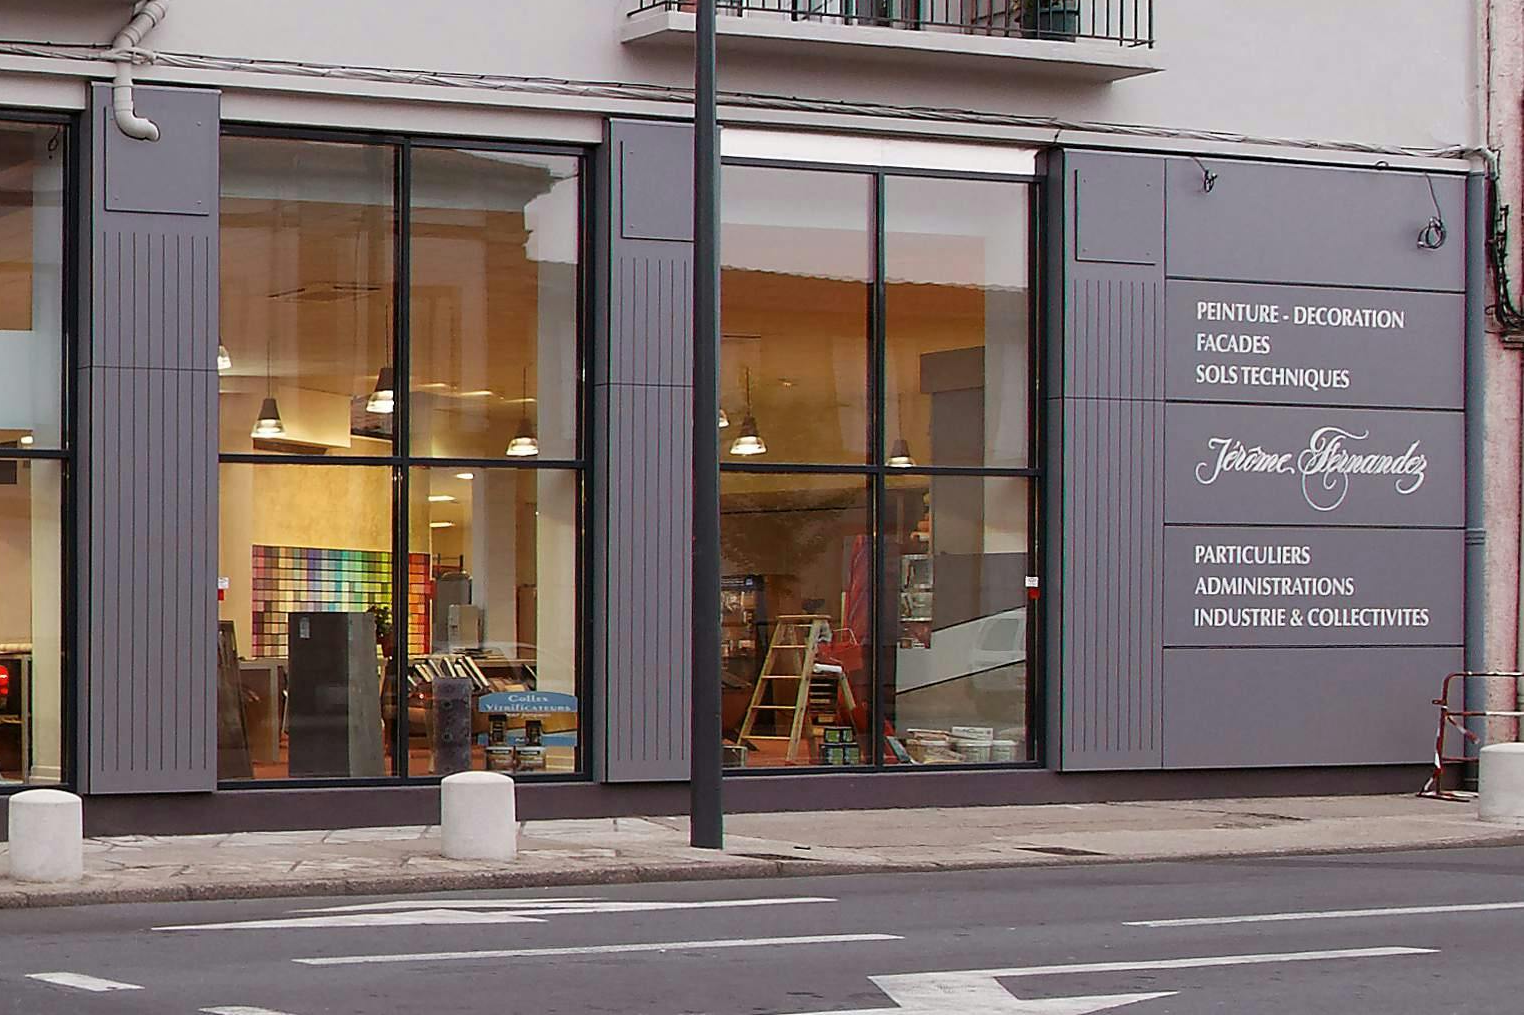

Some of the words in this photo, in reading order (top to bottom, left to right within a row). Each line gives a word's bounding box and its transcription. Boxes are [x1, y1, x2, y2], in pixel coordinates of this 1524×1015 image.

[1196, 301, 1279, 324] PEINTURE
[1293, 306, 1405, 329] DECORATION
[1196, 333, 1271, 354] FACADES
[1195, 364, 1239, 384] SOLS
[1240, 366, 1351, 391] TECHNIQUES
[1195, 437, 1296, 485] Jérôme
[1297, 426, 1428, 512] Fernandez
[1194, 545, 1311, 564] PARTICULIERS
[1194, 577, 1355, 596] ADMINISTRATIONS
[1193, 608, 1286, 627] INDUSTRIE
[1289, 608, 1303, 627] &
[1307, 608, 1430, 627] COLLECTIVITES
